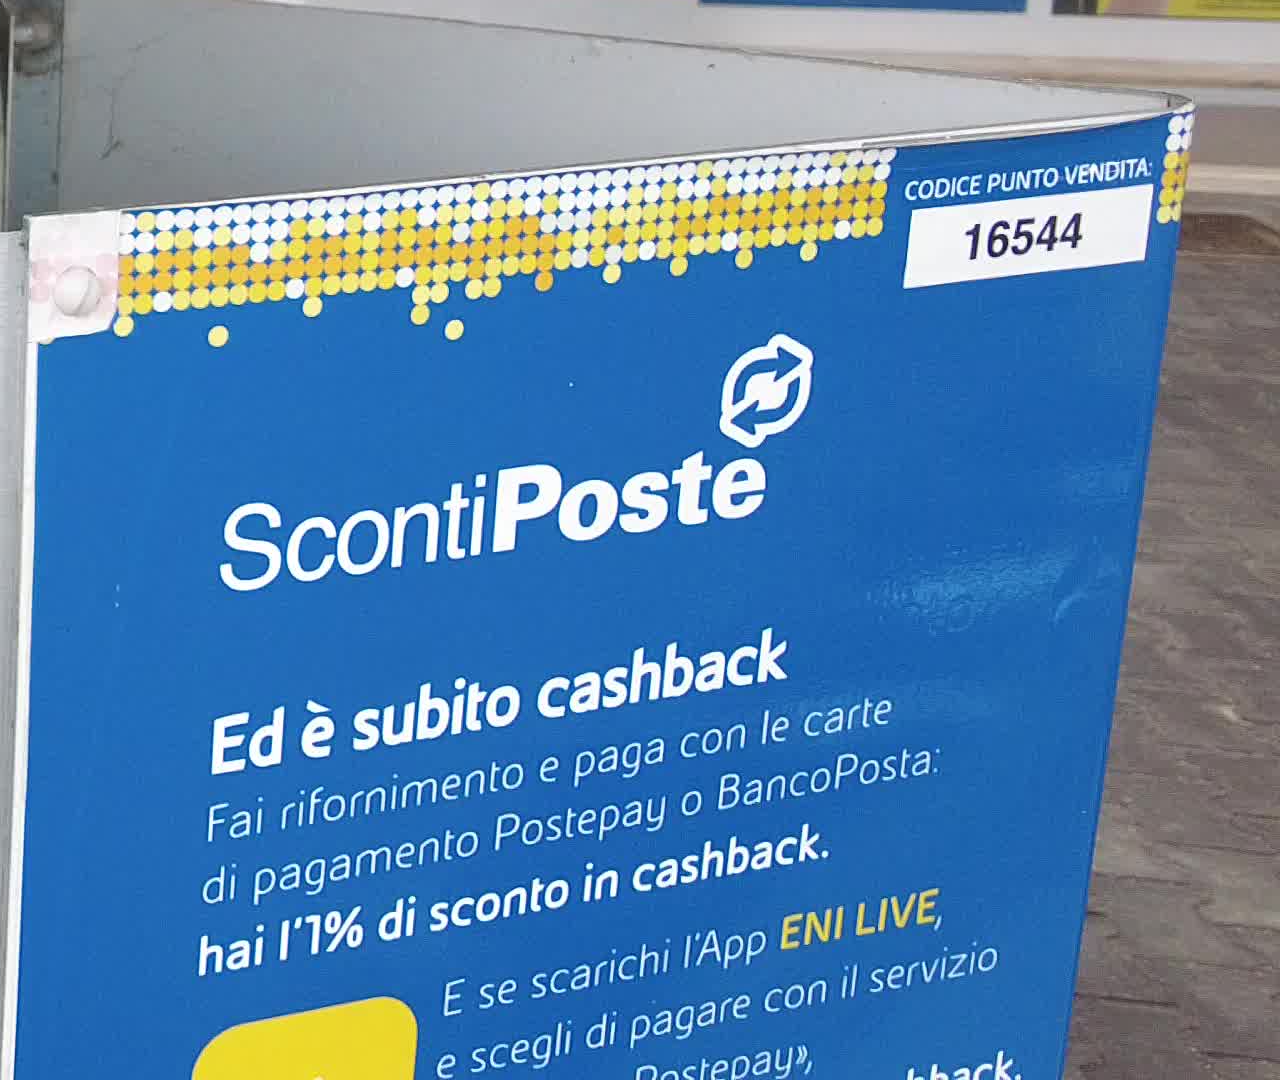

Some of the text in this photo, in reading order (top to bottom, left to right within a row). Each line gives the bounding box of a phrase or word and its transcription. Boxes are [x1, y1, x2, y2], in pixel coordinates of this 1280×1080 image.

[904, 157, 1153, 201] CODICE PUNTO VENDITA:
[965, 212, 1083, 260] 16544
[219, 451, 767, 592] ScontiPoste
[206, 697, 894, 842] Fai rifornimento e paga con le carte
[210, 627, 788, 775] Ed è subito cashback
[202, 746, 941, 905] di pagamento Postepay o BancoPosta:
[198, 823, 830, 976] hai l'1% di sconto in cashback.
[443, 887, 943, 1017] E se scarichi l'App ENI LIVE,
[436, 942, 999, 1080] e scegli di pagare con il servizio
